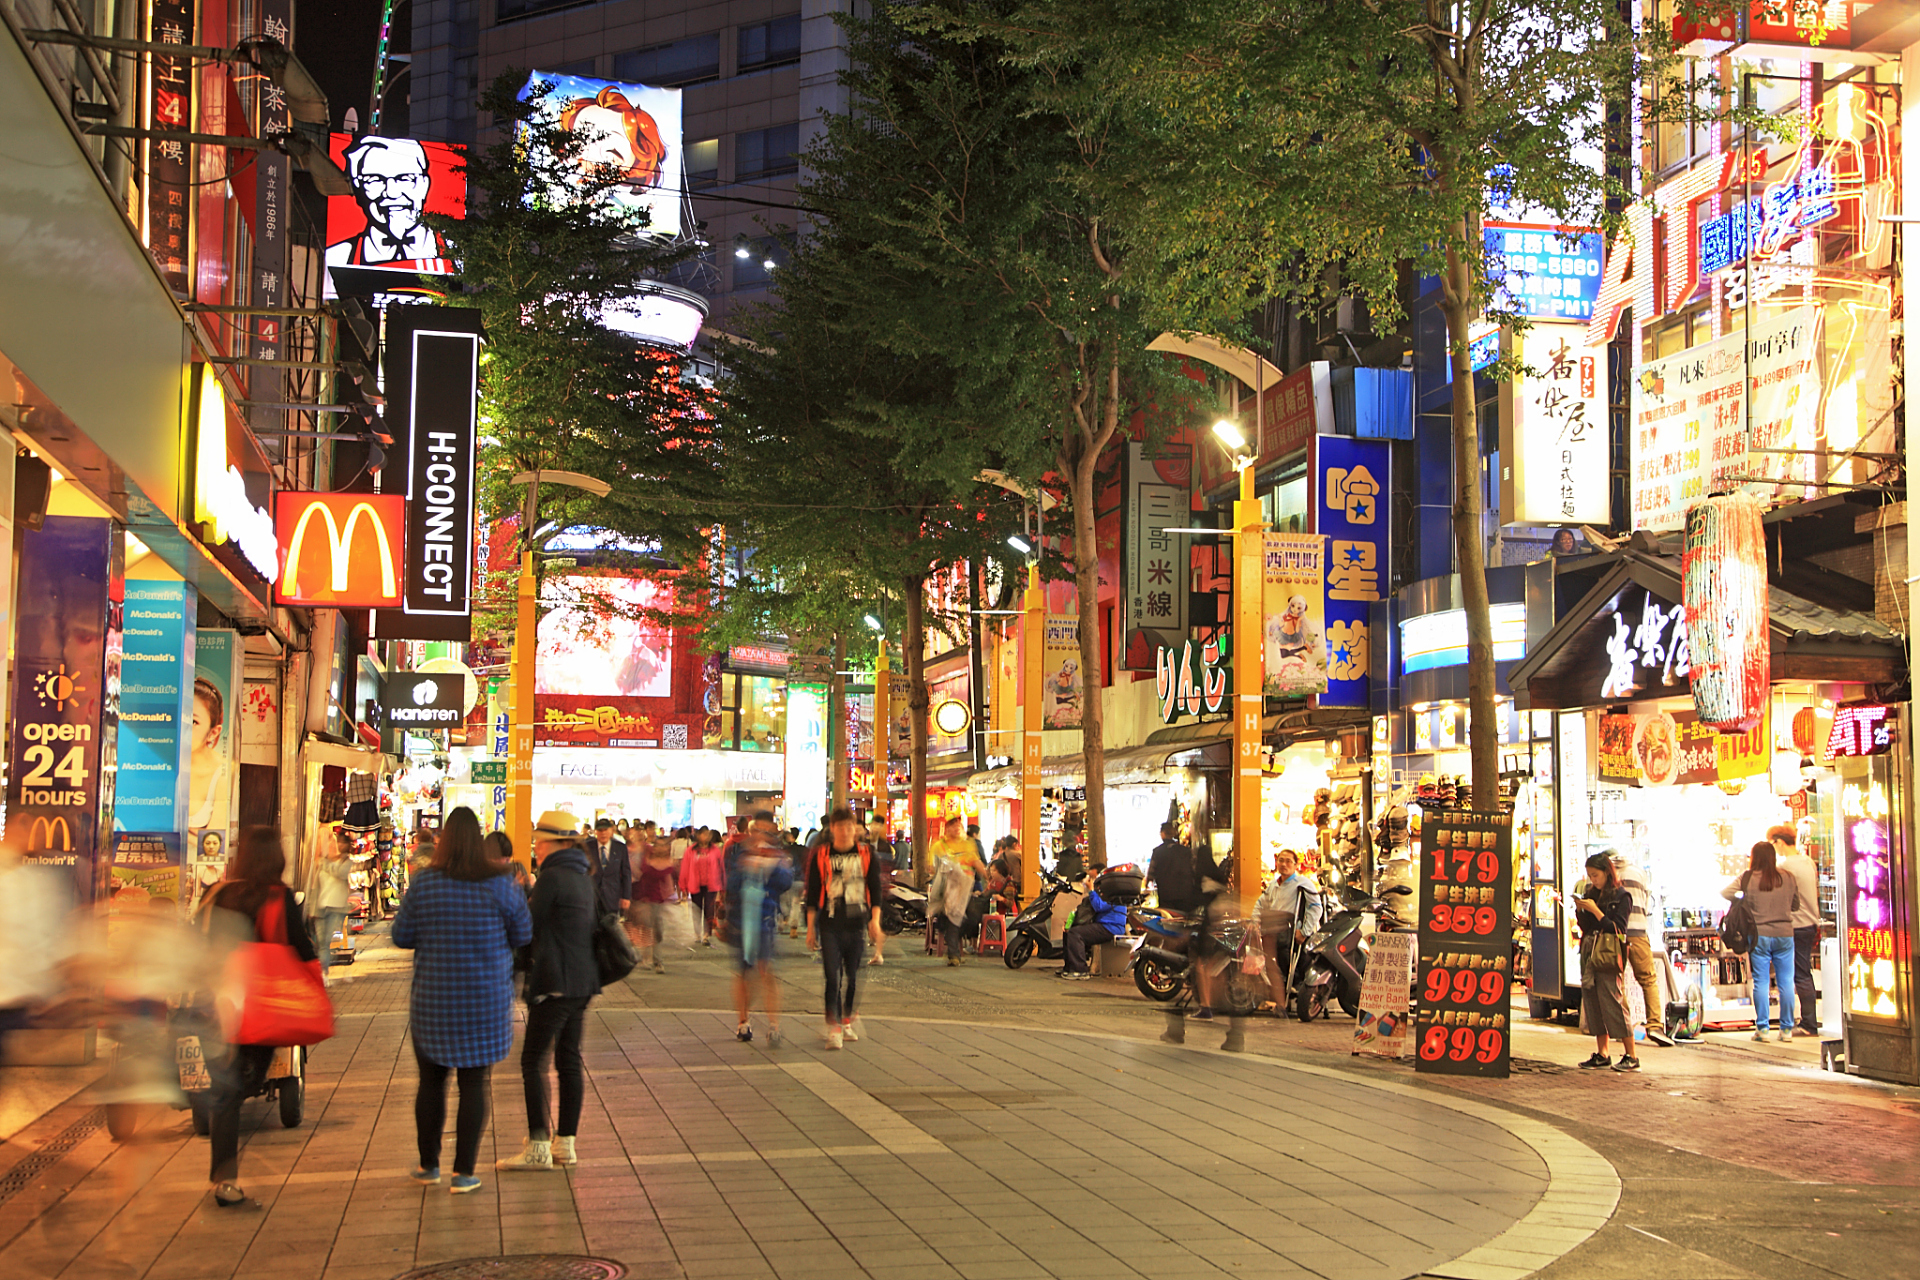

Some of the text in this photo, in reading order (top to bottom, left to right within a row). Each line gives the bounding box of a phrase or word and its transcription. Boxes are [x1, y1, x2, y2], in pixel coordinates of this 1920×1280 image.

[266, 165, 278, 241] 創立於1986年
[1581, 357, 1593, 397] ラーメン
[423, 431, 457, 602] H:CONNECT
[1147, 495, 1173, 618] 三哥米線
[1266, 551, 1319, 569] 西門町
[1326, 464, 1381, 682] 哈星族
[130, 610, 182, 620] McDonald's
[1133, 597, 1143, 620] 香港
[121, 653, 176, 662] McDonald's
[118, 712, 172, 722] McDonald's
[23, 722, 91, 745] open
[1873, 727, 1890, 745] 25
[1242, 742, 1261, 756] 37
[21, 744, 89, 787] 24
[122, 762, 172, 771] McDonald's
[475, 763, 504, 774] 漢中街
[516, 760, 532, 771] 30
[558, 763, 605, 777] FACE
[1026, 766, 1041, 775] 35
[20, 787, 87, 806] hours
[1436, 829, 1498, 849] 學生單剪
[114, 851, 169, 864] 百元有找
[1430, 848, 1500, 884] 179
[1433, 884, 1495, 905] 學生洗剪
[1429, 904, 1498, 936] 359
[1849, 928, 1893, 959] 25000
[1385, 984, 1406, 993] Taiwan
[1424, 967, 1505, 1006] 999
[1360, 992, 1409, 1004] ower Bank
[1420, 1025, 1504, 1064] 899
